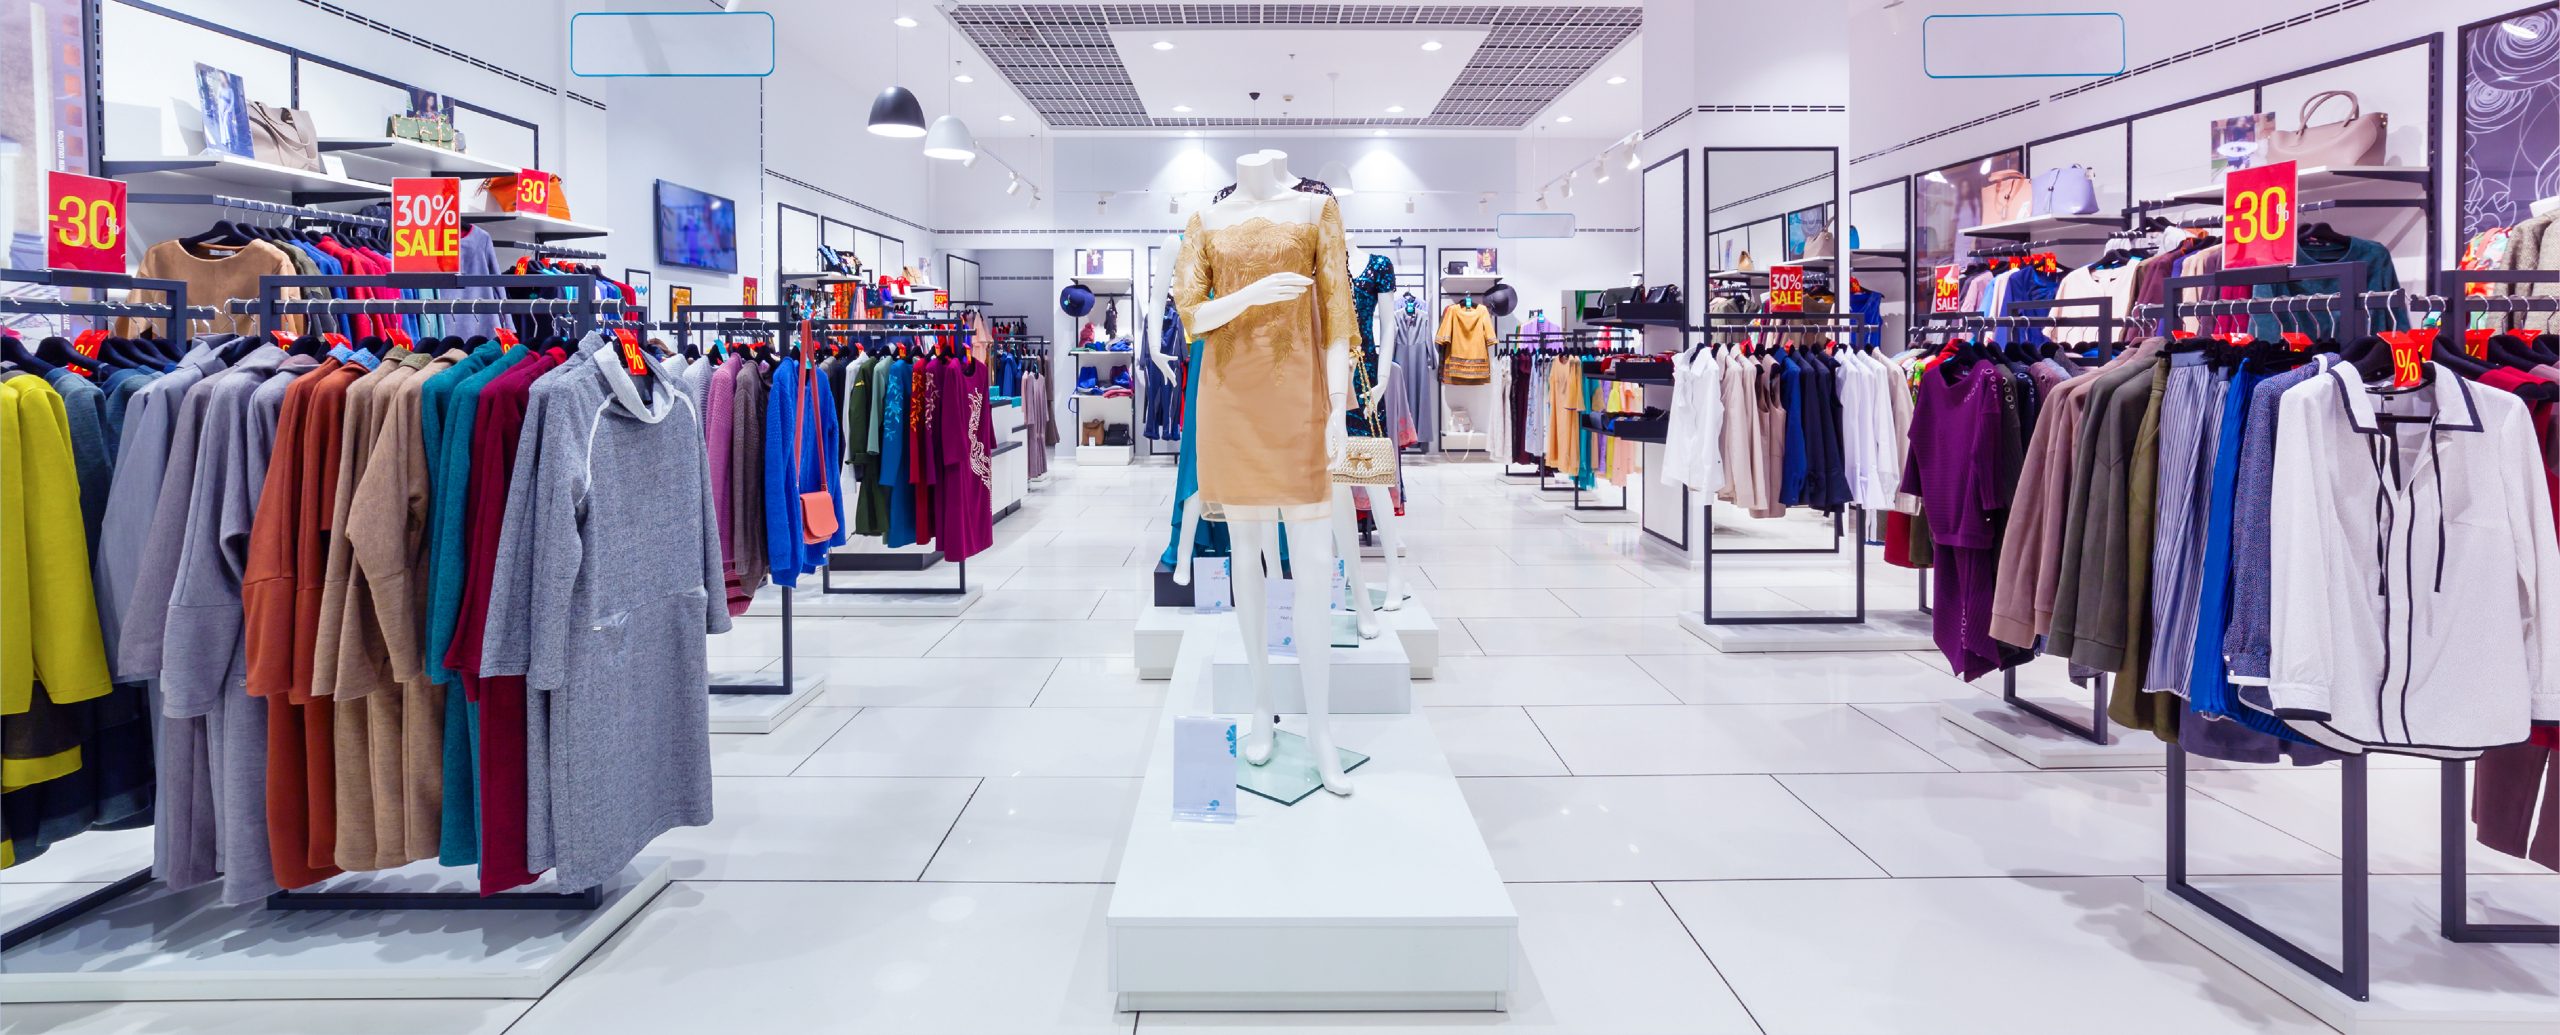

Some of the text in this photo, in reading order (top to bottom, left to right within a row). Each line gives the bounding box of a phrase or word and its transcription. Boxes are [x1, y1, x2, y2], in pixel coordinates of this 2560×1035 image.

[396, 195, 457, 227] 30%
[395, 228, 459, 257] SALE
[1772, 273, 1801, 290] 30%
[1771, 290, 1802, 305] SALE
[1936, 297, 1958, 311] SALE
[625, 343, 644, 370] %
[2395, 348, 2419, 382] %
